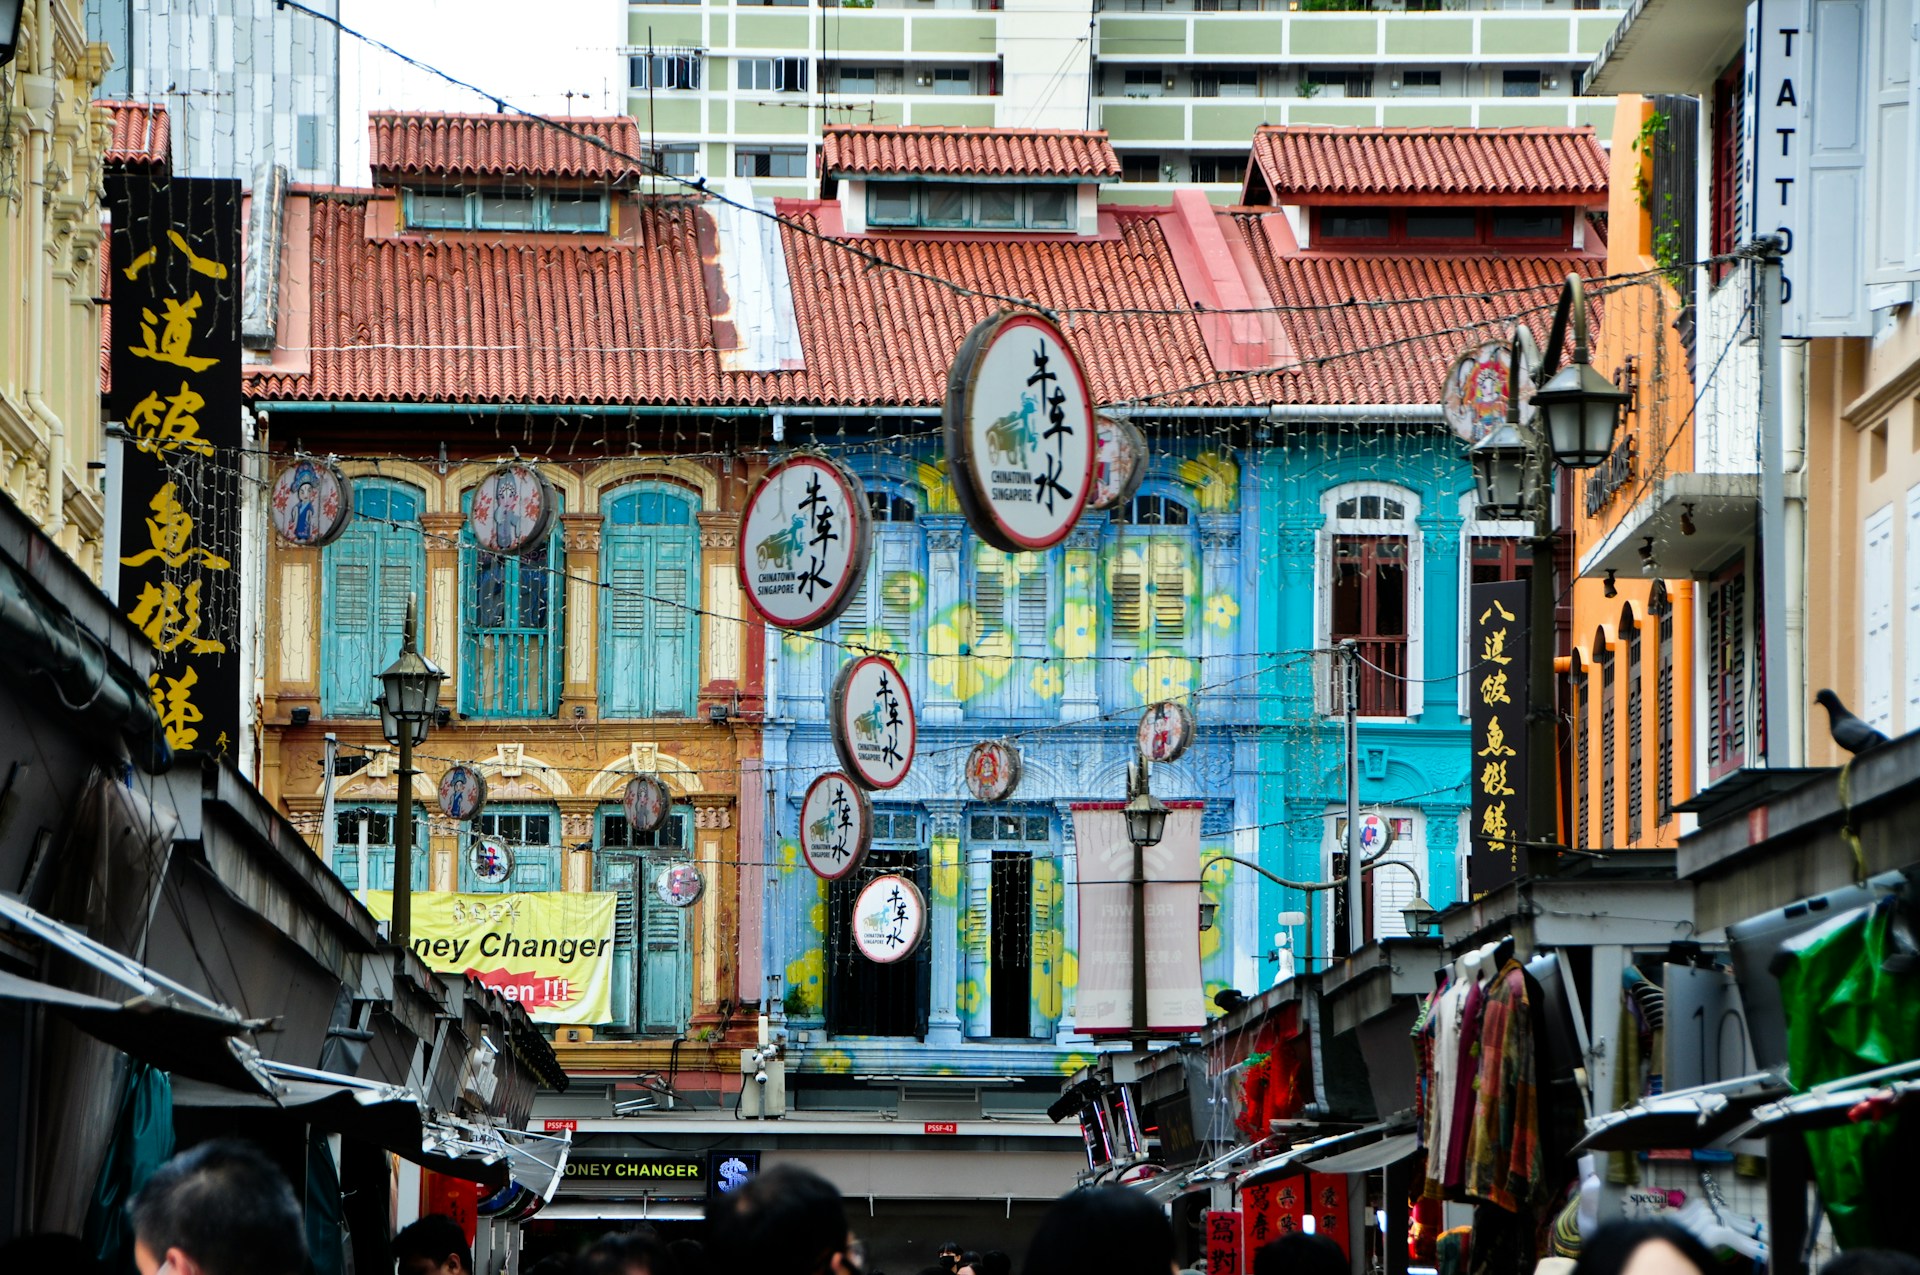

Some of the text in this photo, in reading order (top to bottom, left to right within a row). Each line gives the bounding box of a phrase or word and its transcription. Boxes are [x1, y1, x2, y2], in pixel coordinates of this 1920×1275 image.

[991, 470, 1032, 485] CHINATOWN
[992, 487, 1033, 502] SINGAPORE
[758, 571, 796, 583] CHINATOWN
[757, 583, 795, 596] SINGAPORE
[857, 743, 881, 753] CHINATOWN
[857, 752, 882, 762] SINGAPORE
[413, 932, 611, 964] ney Changer
[547, 1121, 574, 1130] PSSF-44
[927, 1124, 954, 1133] PSSF-42
[562, 1164, 699, 1177] ONEY CHANGER
[1630, 1191, 1667, 1206] special
